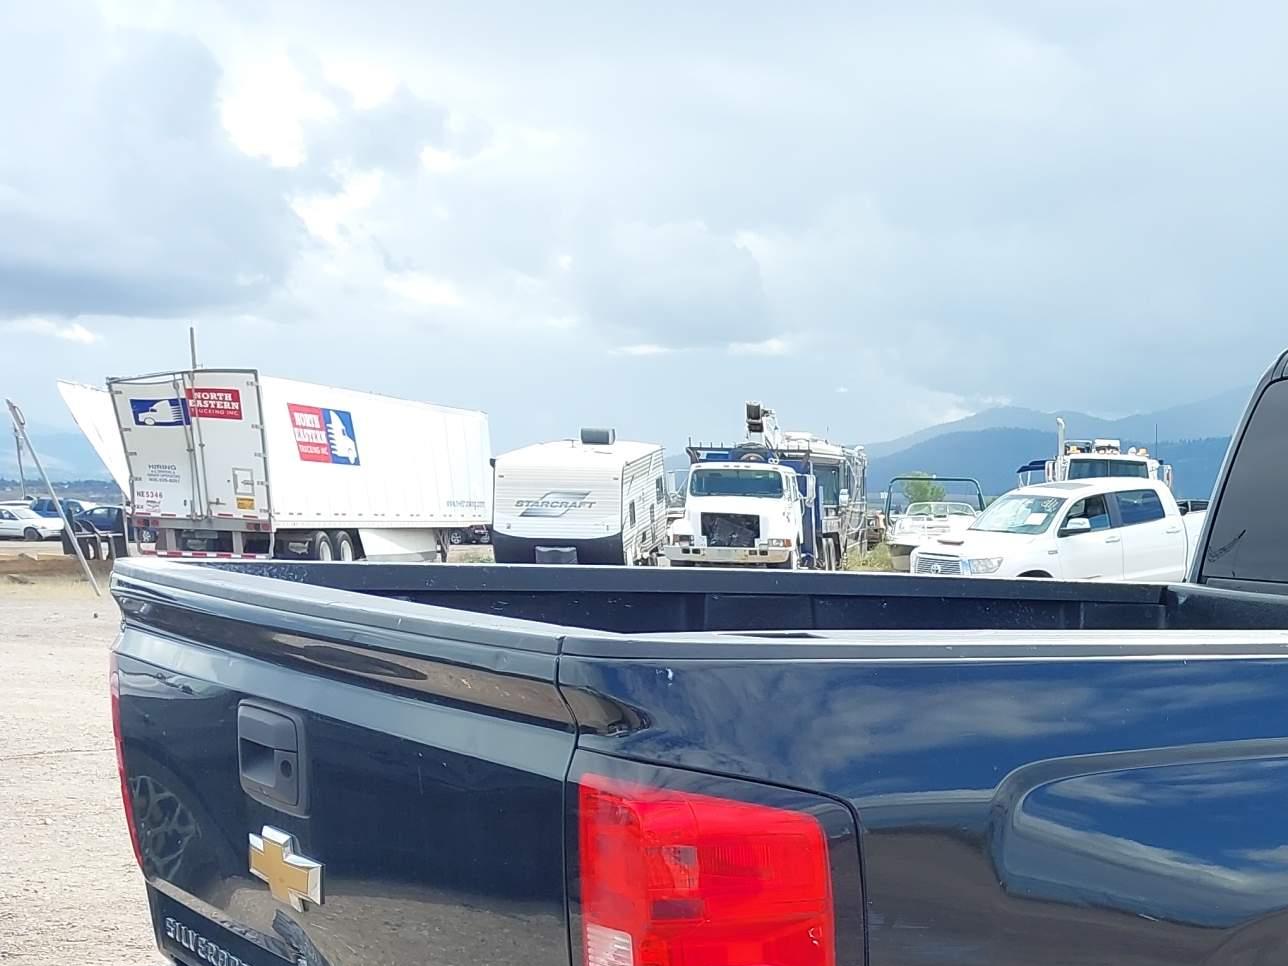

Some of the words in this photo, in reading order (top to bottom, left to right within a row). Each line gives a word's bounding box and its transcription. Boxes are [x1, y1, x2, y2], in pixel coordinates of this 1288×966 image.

[193, 392, 232, 401] NORTH
[189, 400, 239, 410] EASTERN
[515, 500, 597, 509] STARCRAFT
